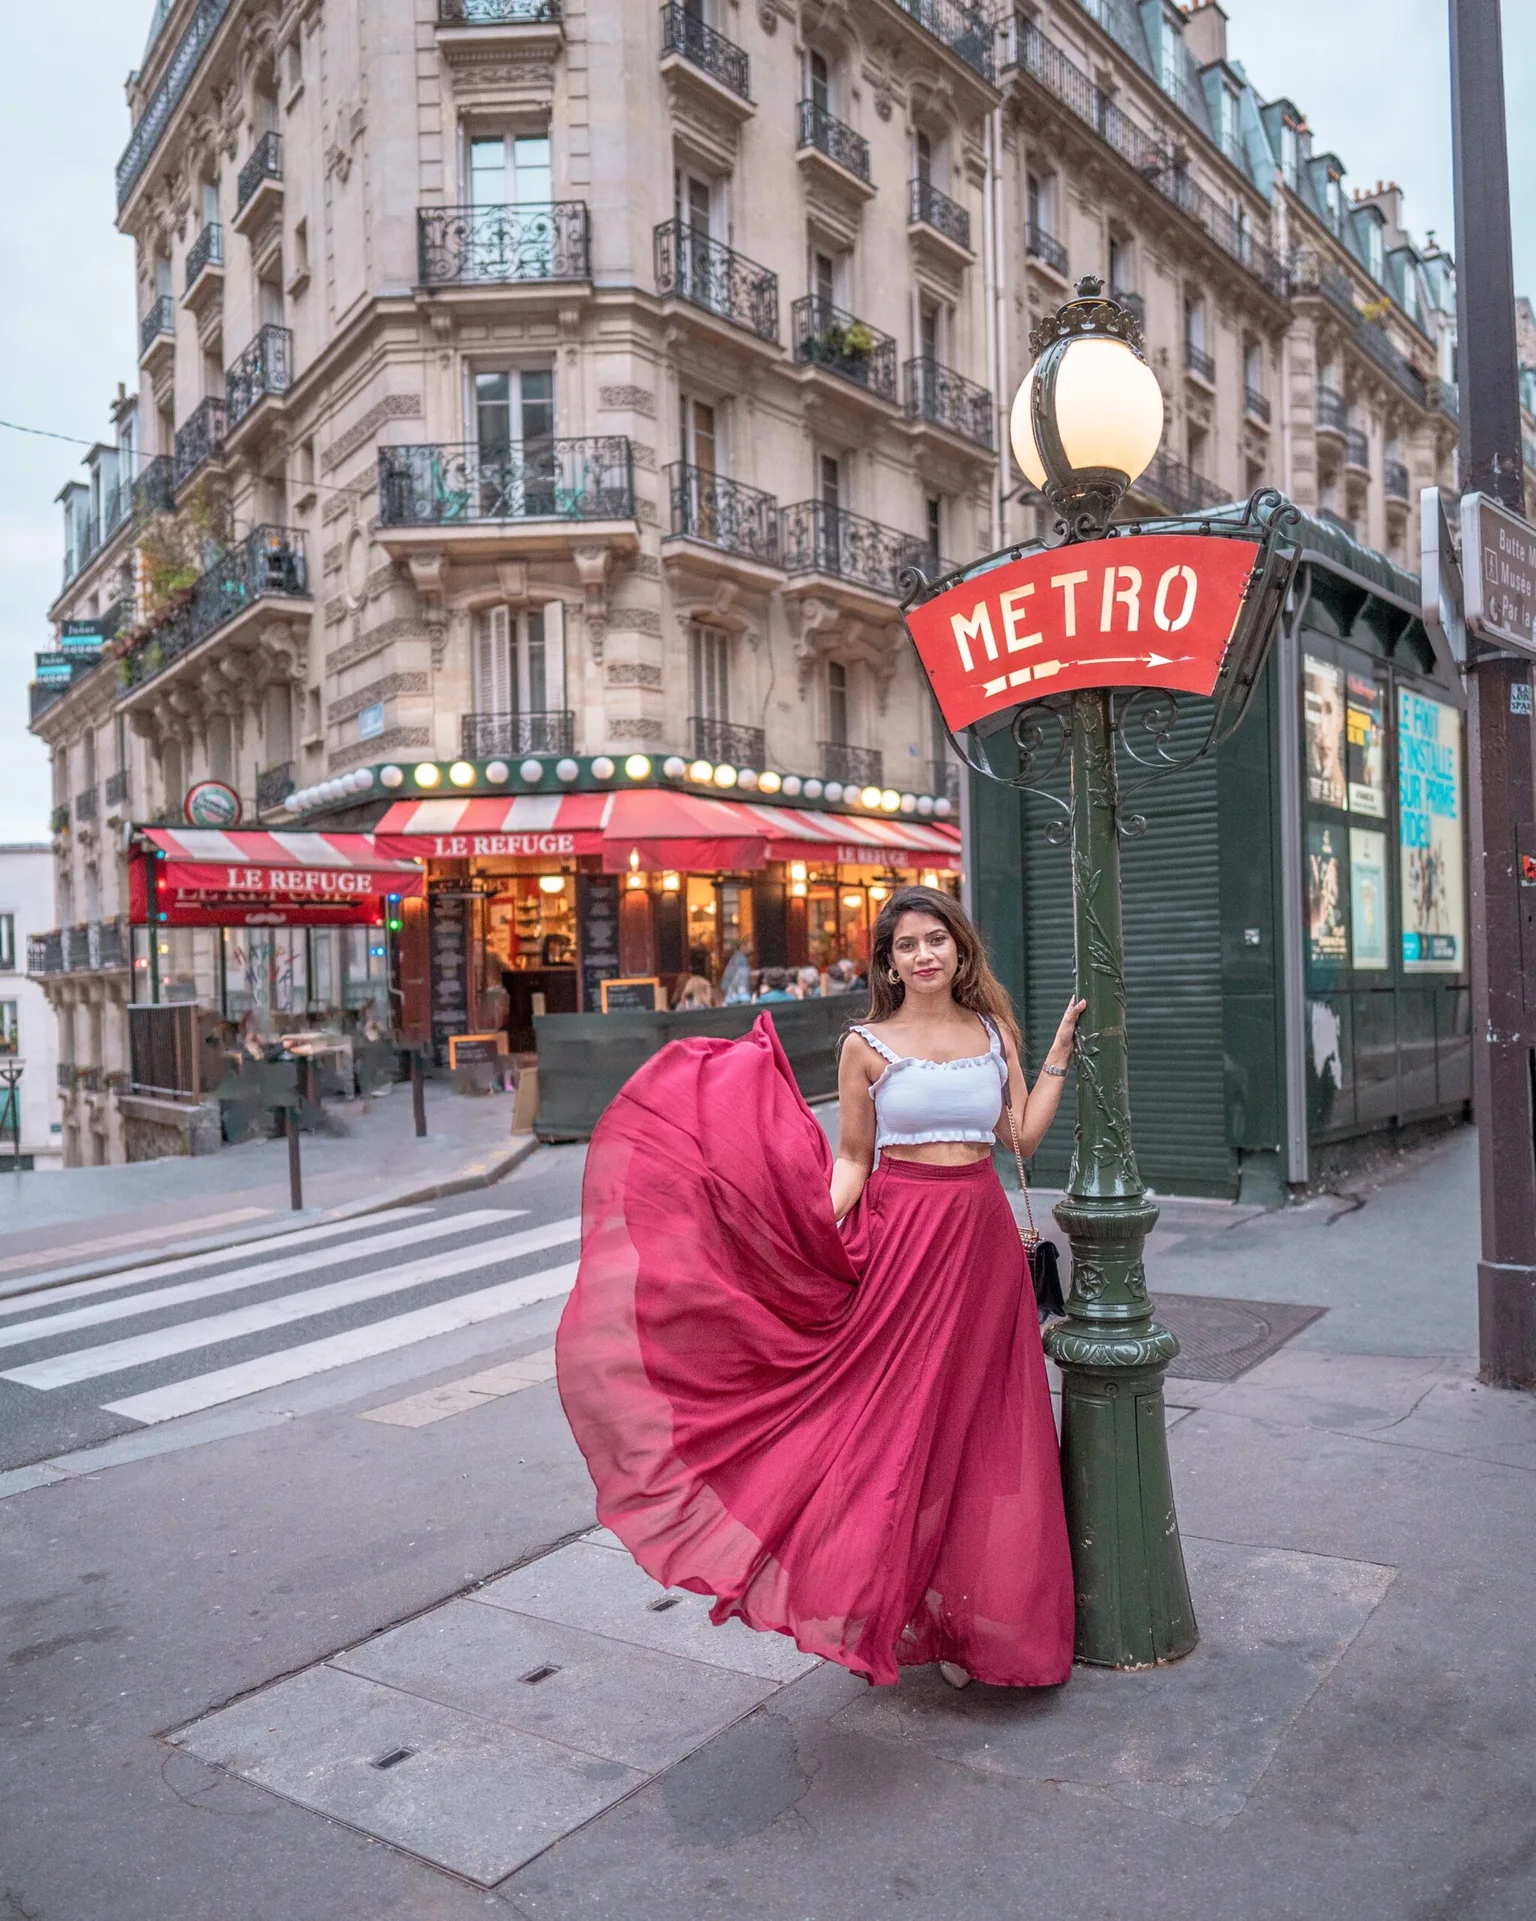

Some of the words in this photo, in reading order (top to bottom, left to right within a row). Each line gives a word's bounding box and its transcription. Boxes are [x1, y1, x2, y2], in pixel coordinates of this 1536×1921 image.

[1499, 528, 1525, 562] Butte
[1501, 560, 1532, 597] Musée
[949, 564, 1199, 673] METRO
[1502, 595, 1518, 624] Par
[1521, 603, 1530, 628] la
[434, 836, 468, 857] LE
[473, 833, 574, 856] REFUGE
[227, 867, 263, 889] LE
[269, 869, 372, 893] REFUGE
